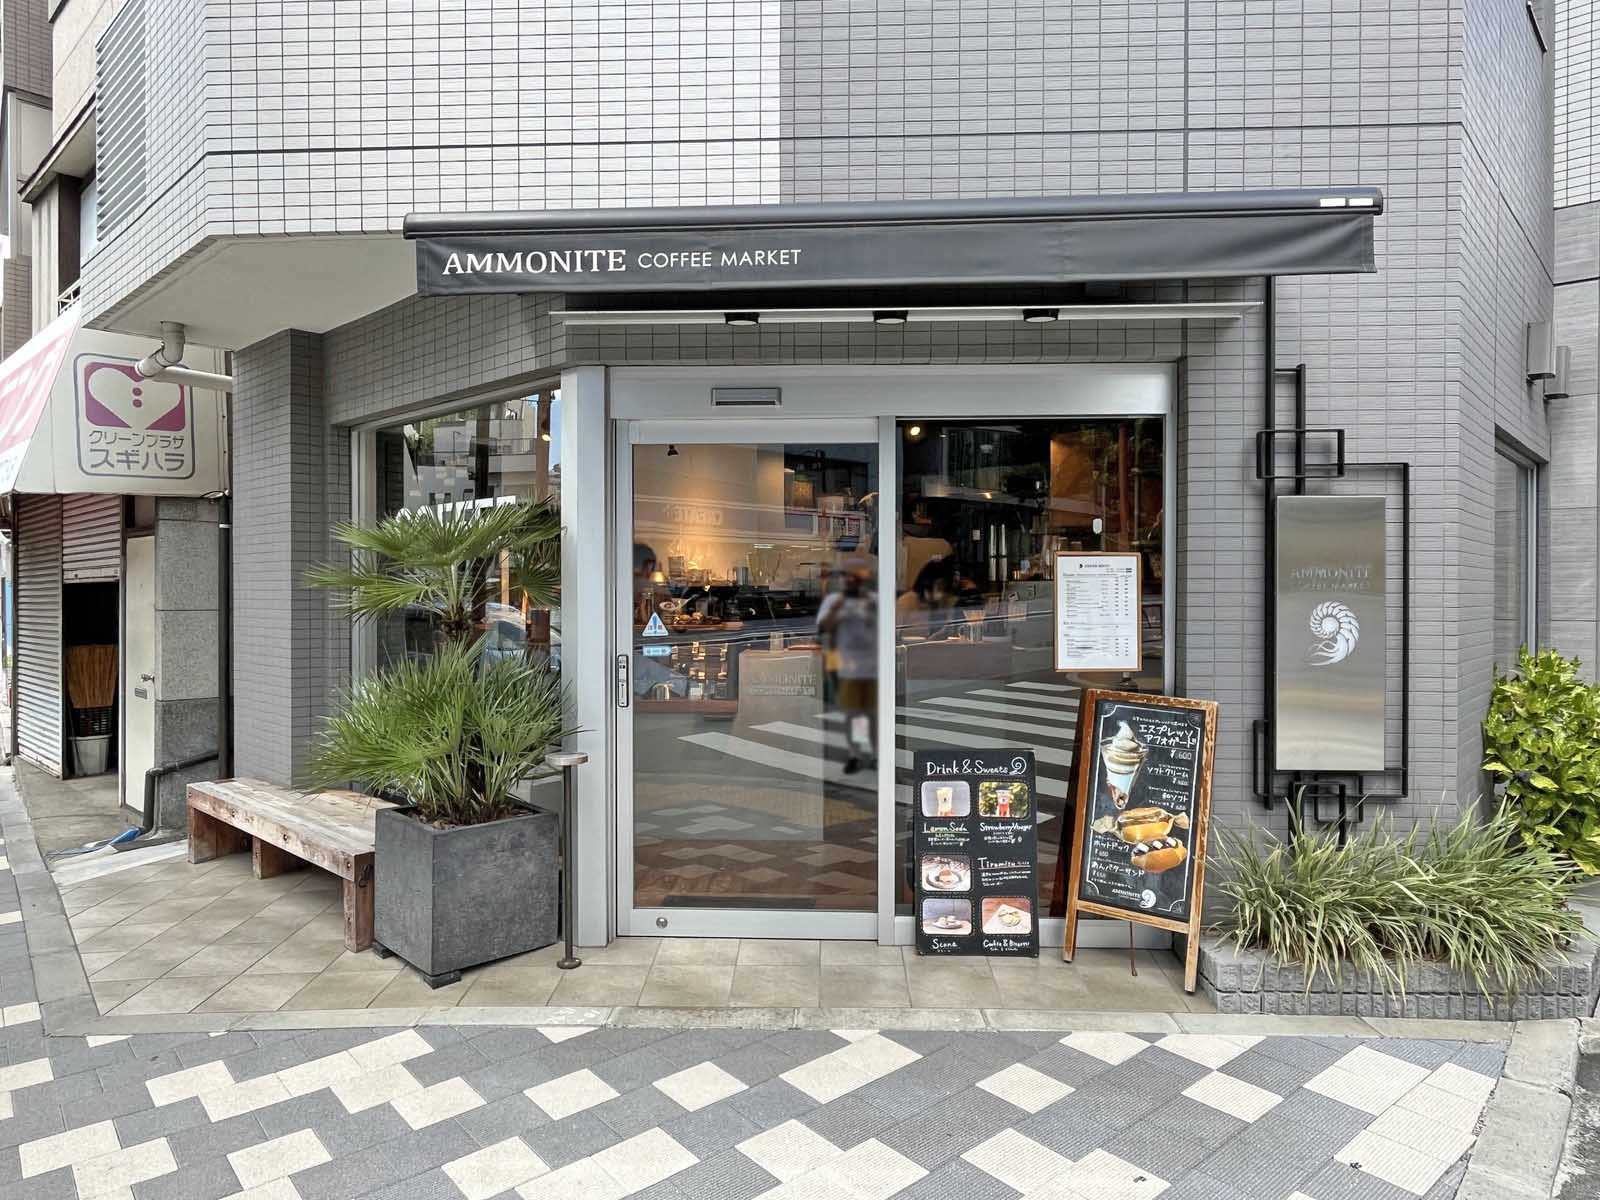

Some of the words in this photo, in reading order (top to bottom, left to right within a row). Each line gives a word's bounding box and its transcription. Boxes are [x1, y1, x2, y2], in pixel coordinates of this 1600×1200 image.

[442, 249, 627, 276] AMMONITE
[637, 251, 712, 269] COFFEE
[720, 248, 802, 267] MARKET
[90, 448, 185, 472] スギハラ
[1138, 724, 1193, 738] エスプレッソ
[926, 760, 960, 775] Drink
[961, 758, 972, 774] &
[1147, 767, 1189, 778] ソフトクリーム
[923, 822, 949, 833] Lemon
[949, 821, 968, 832] Soda
